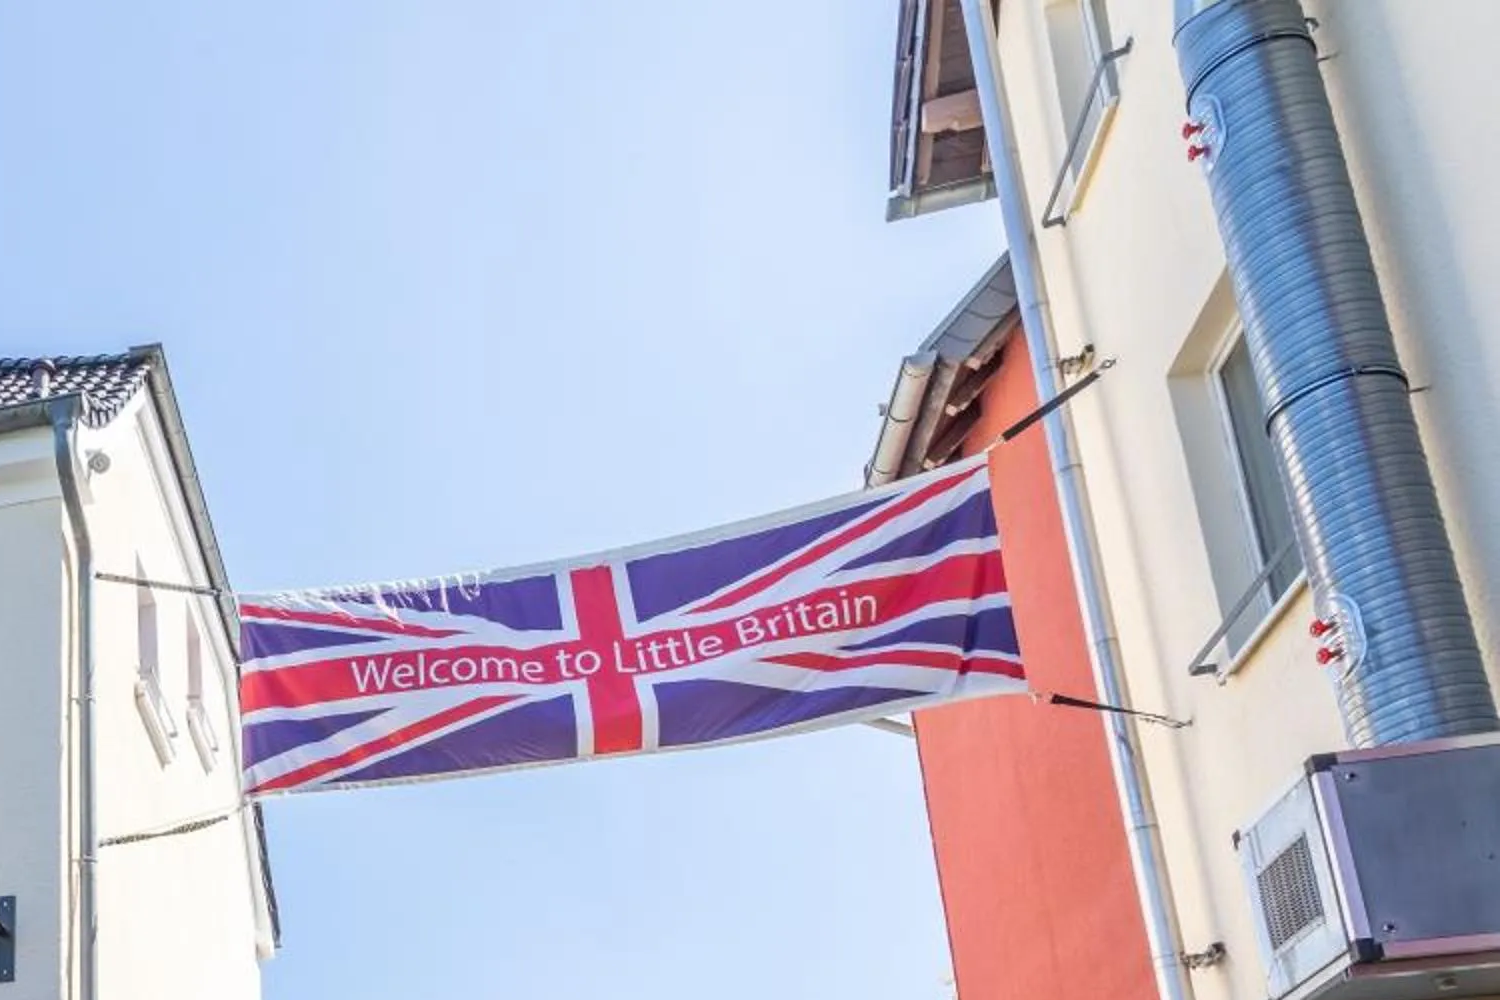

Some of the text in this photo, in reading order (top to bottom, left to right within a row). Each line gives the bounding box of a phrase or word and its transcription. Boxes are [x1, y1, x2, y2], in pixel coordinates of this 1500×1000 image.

[350, 592, 879, 695] Welcome to Little Britain
